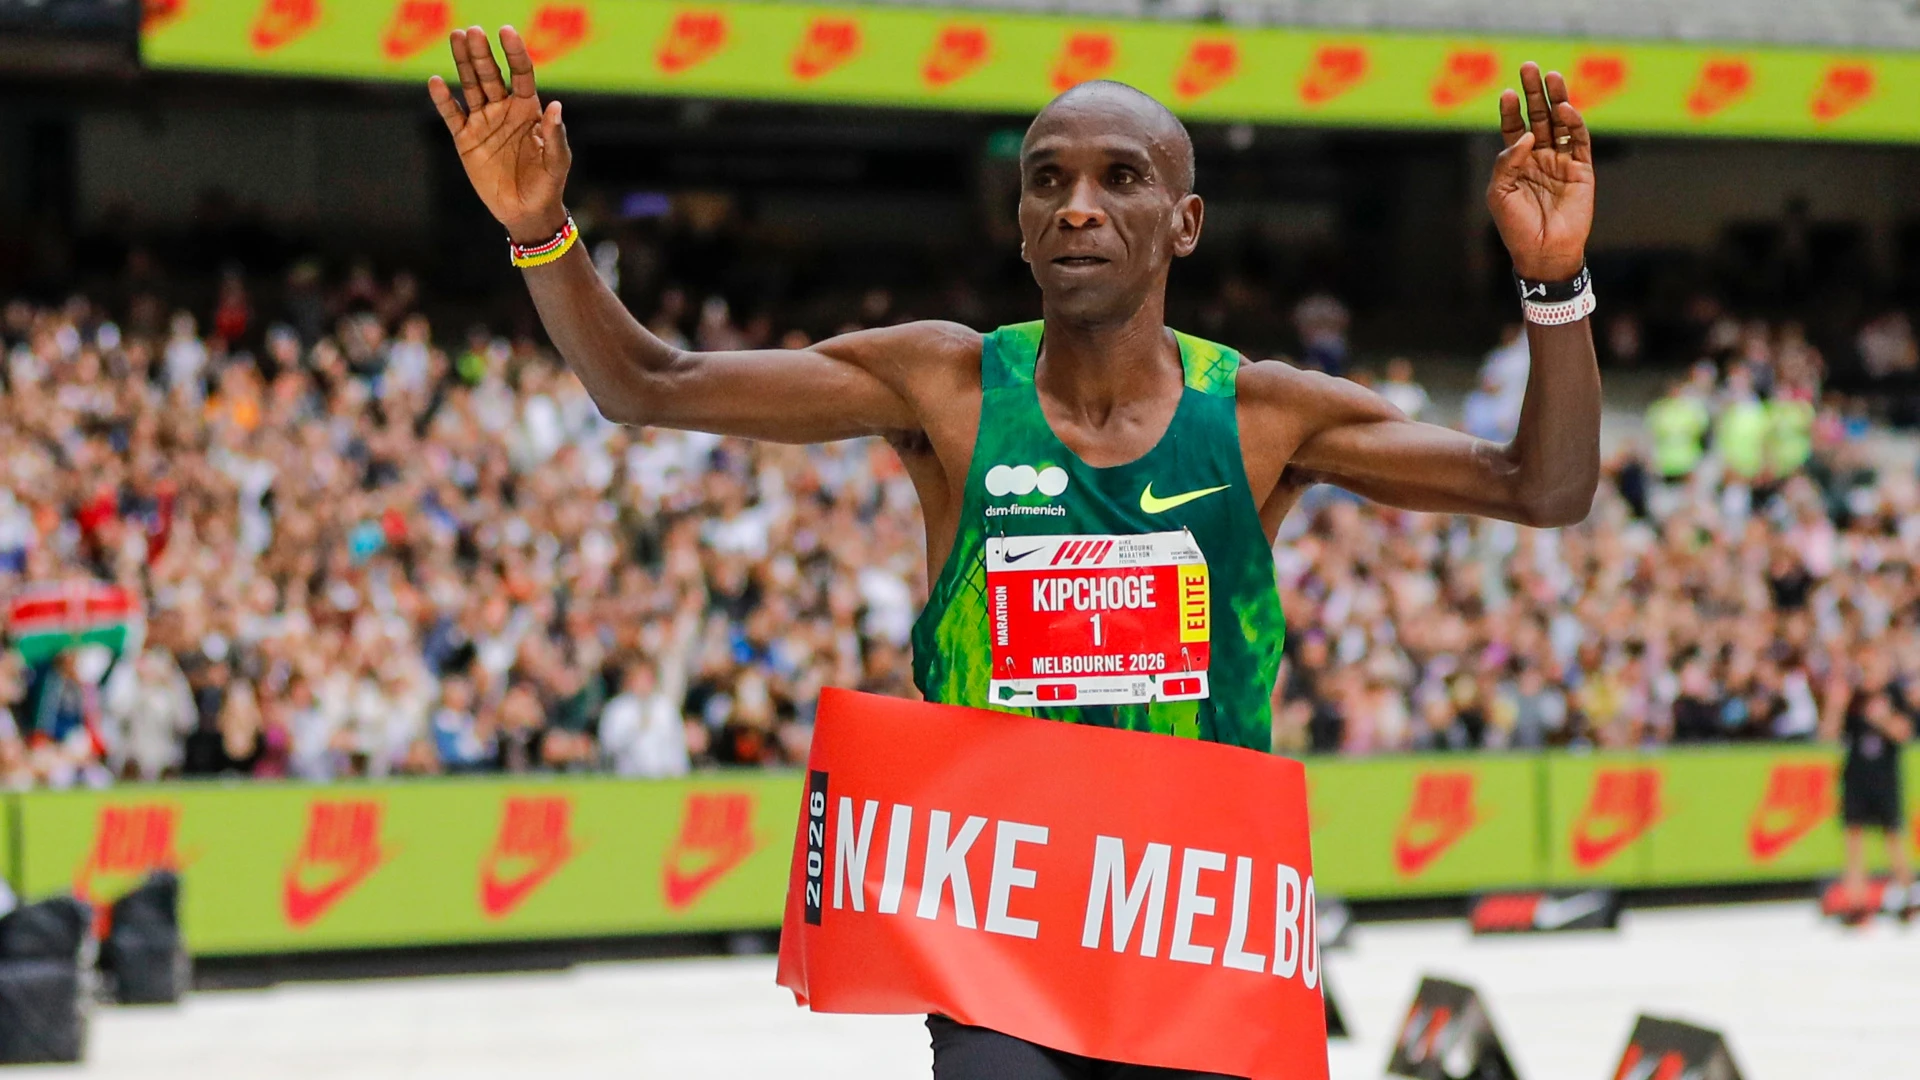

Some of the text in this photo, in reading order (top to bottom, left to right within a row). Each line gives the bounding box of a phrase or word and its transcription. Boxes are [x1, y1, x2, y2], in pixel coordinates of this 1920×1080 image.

[985, 503, 1066, 517] dsm-firmenich
[1118, 551, 1150, 559] MARATHON
[1032, 575, 1157, 612] KIPCHOGE
[1185, 575, 1205, 630] ELITE
[995, 585, 1009, 646] MARATHON
[1089, 613, 1102, 647] 1
[1032, 652, 1166, 674] MELBOURNE 2026
[1053, 686, 1060, 699] 1
[1179, 681, 1186, 693] 1
[806, 791, 825, 908] 2026
[832, 796, 1322, 998] NIKE MELBO
